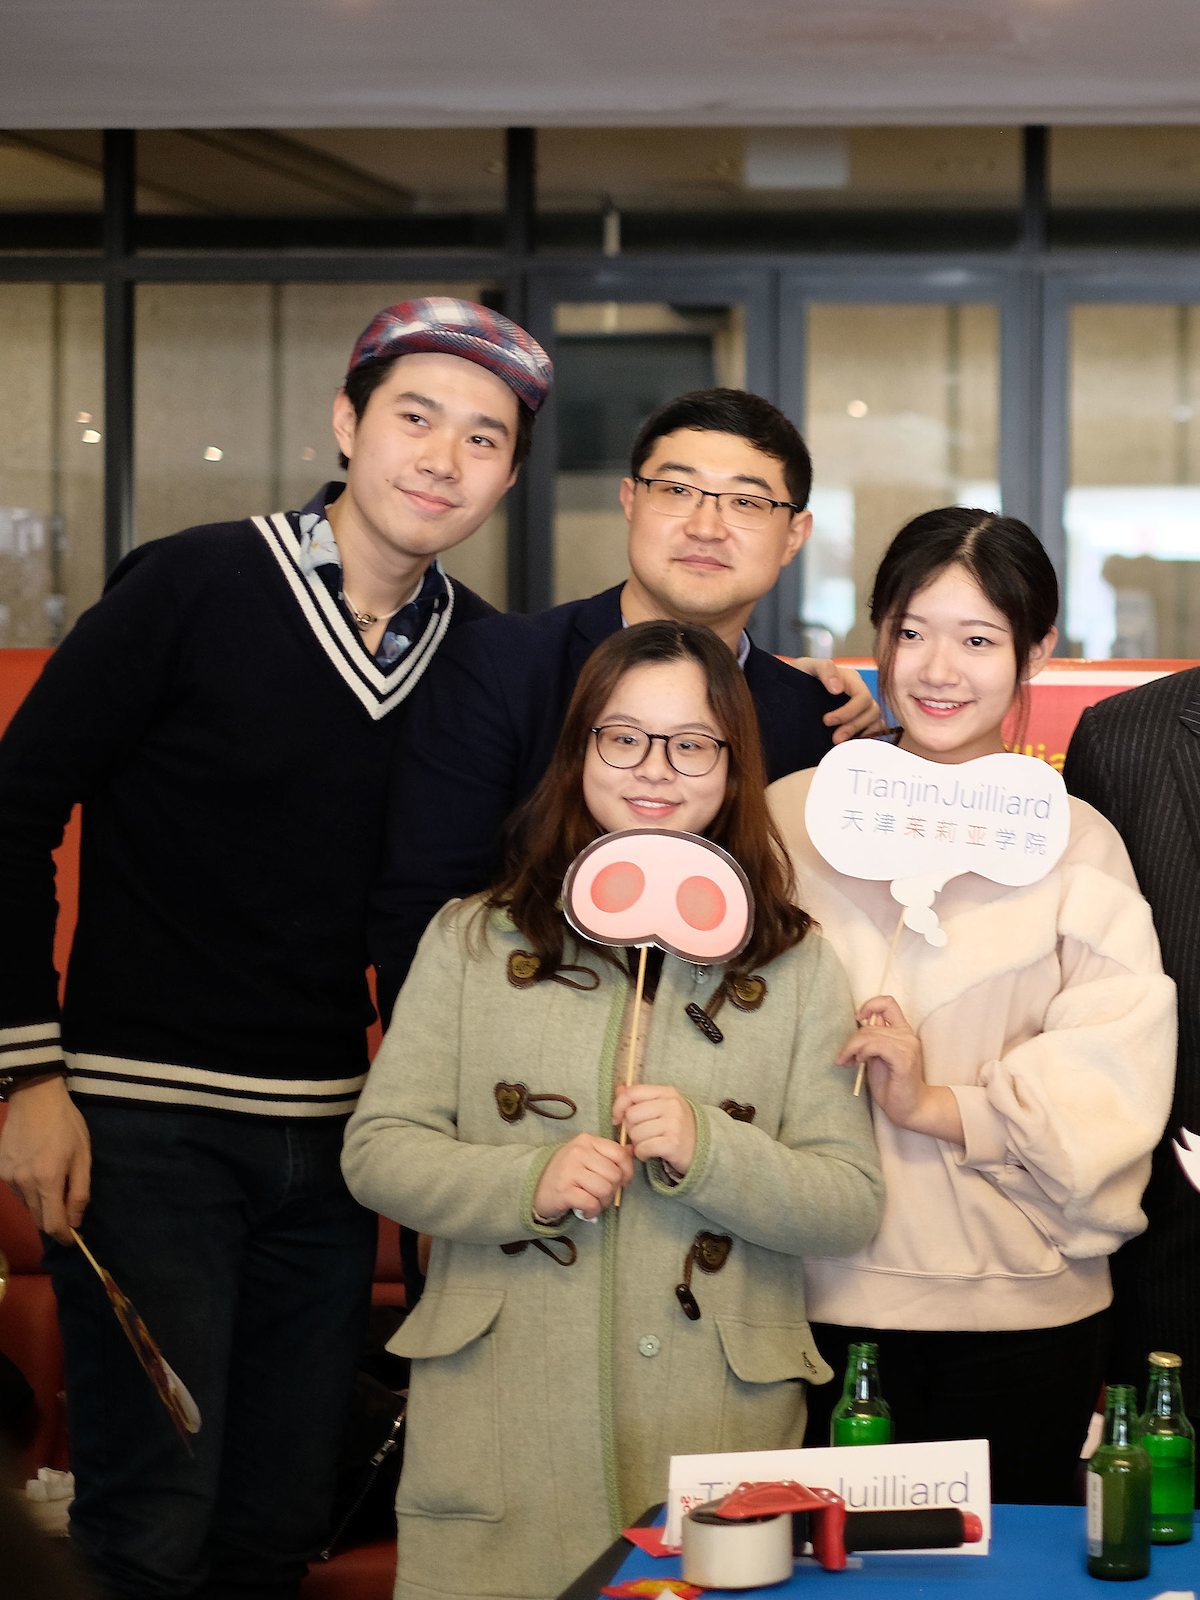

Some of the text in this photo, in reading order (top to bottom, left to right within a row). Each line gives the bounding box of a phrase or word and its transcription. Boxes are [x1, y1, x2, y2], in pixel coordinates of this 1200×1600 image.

[847, 768, 1053, 820] TianjinJuilliard
[841, 808, 1047, 856] 天津茱莉亚学院
